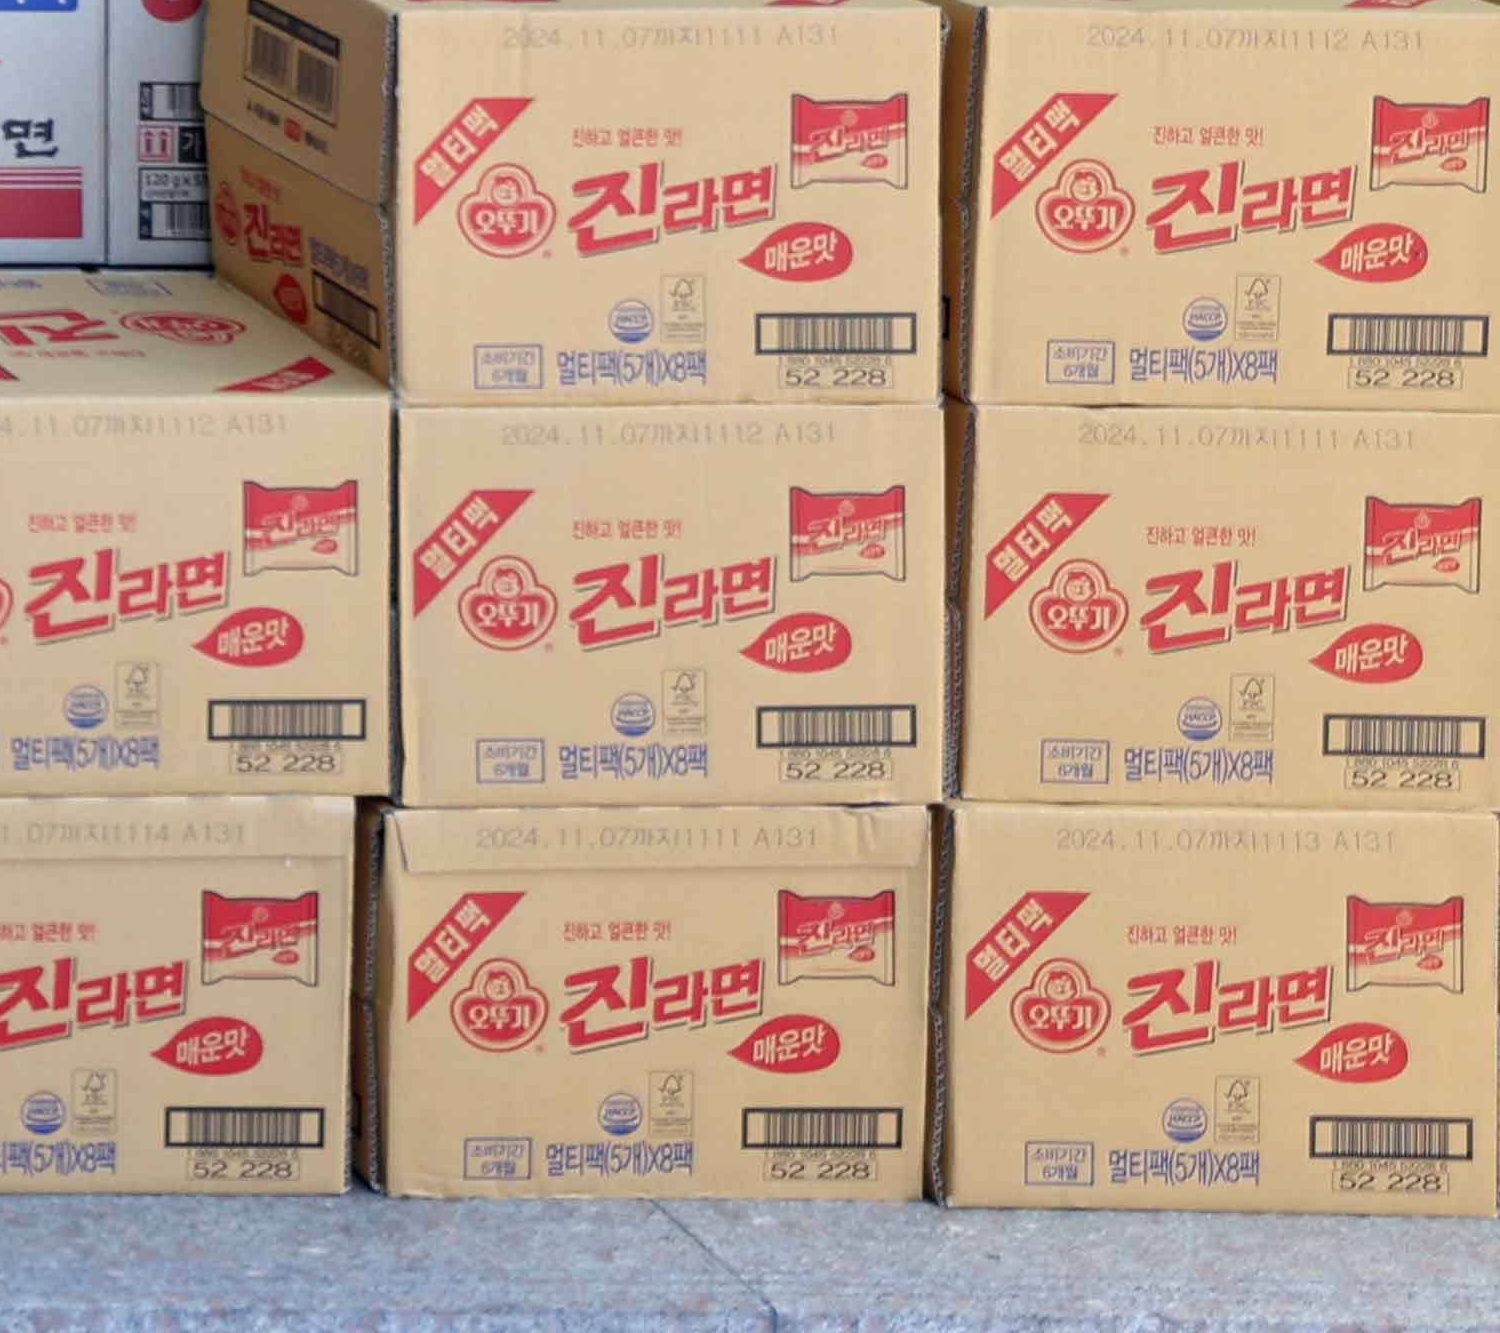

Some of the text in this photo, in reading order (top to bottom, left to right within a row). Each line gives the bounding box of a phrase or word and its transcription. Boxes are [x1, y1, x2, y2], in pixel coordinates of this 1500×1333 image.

[474, 208, 542, 235] 오뚜기
[568, 160, 778, 258] 진라면
[764, 232, 838, 272] 매운맛
